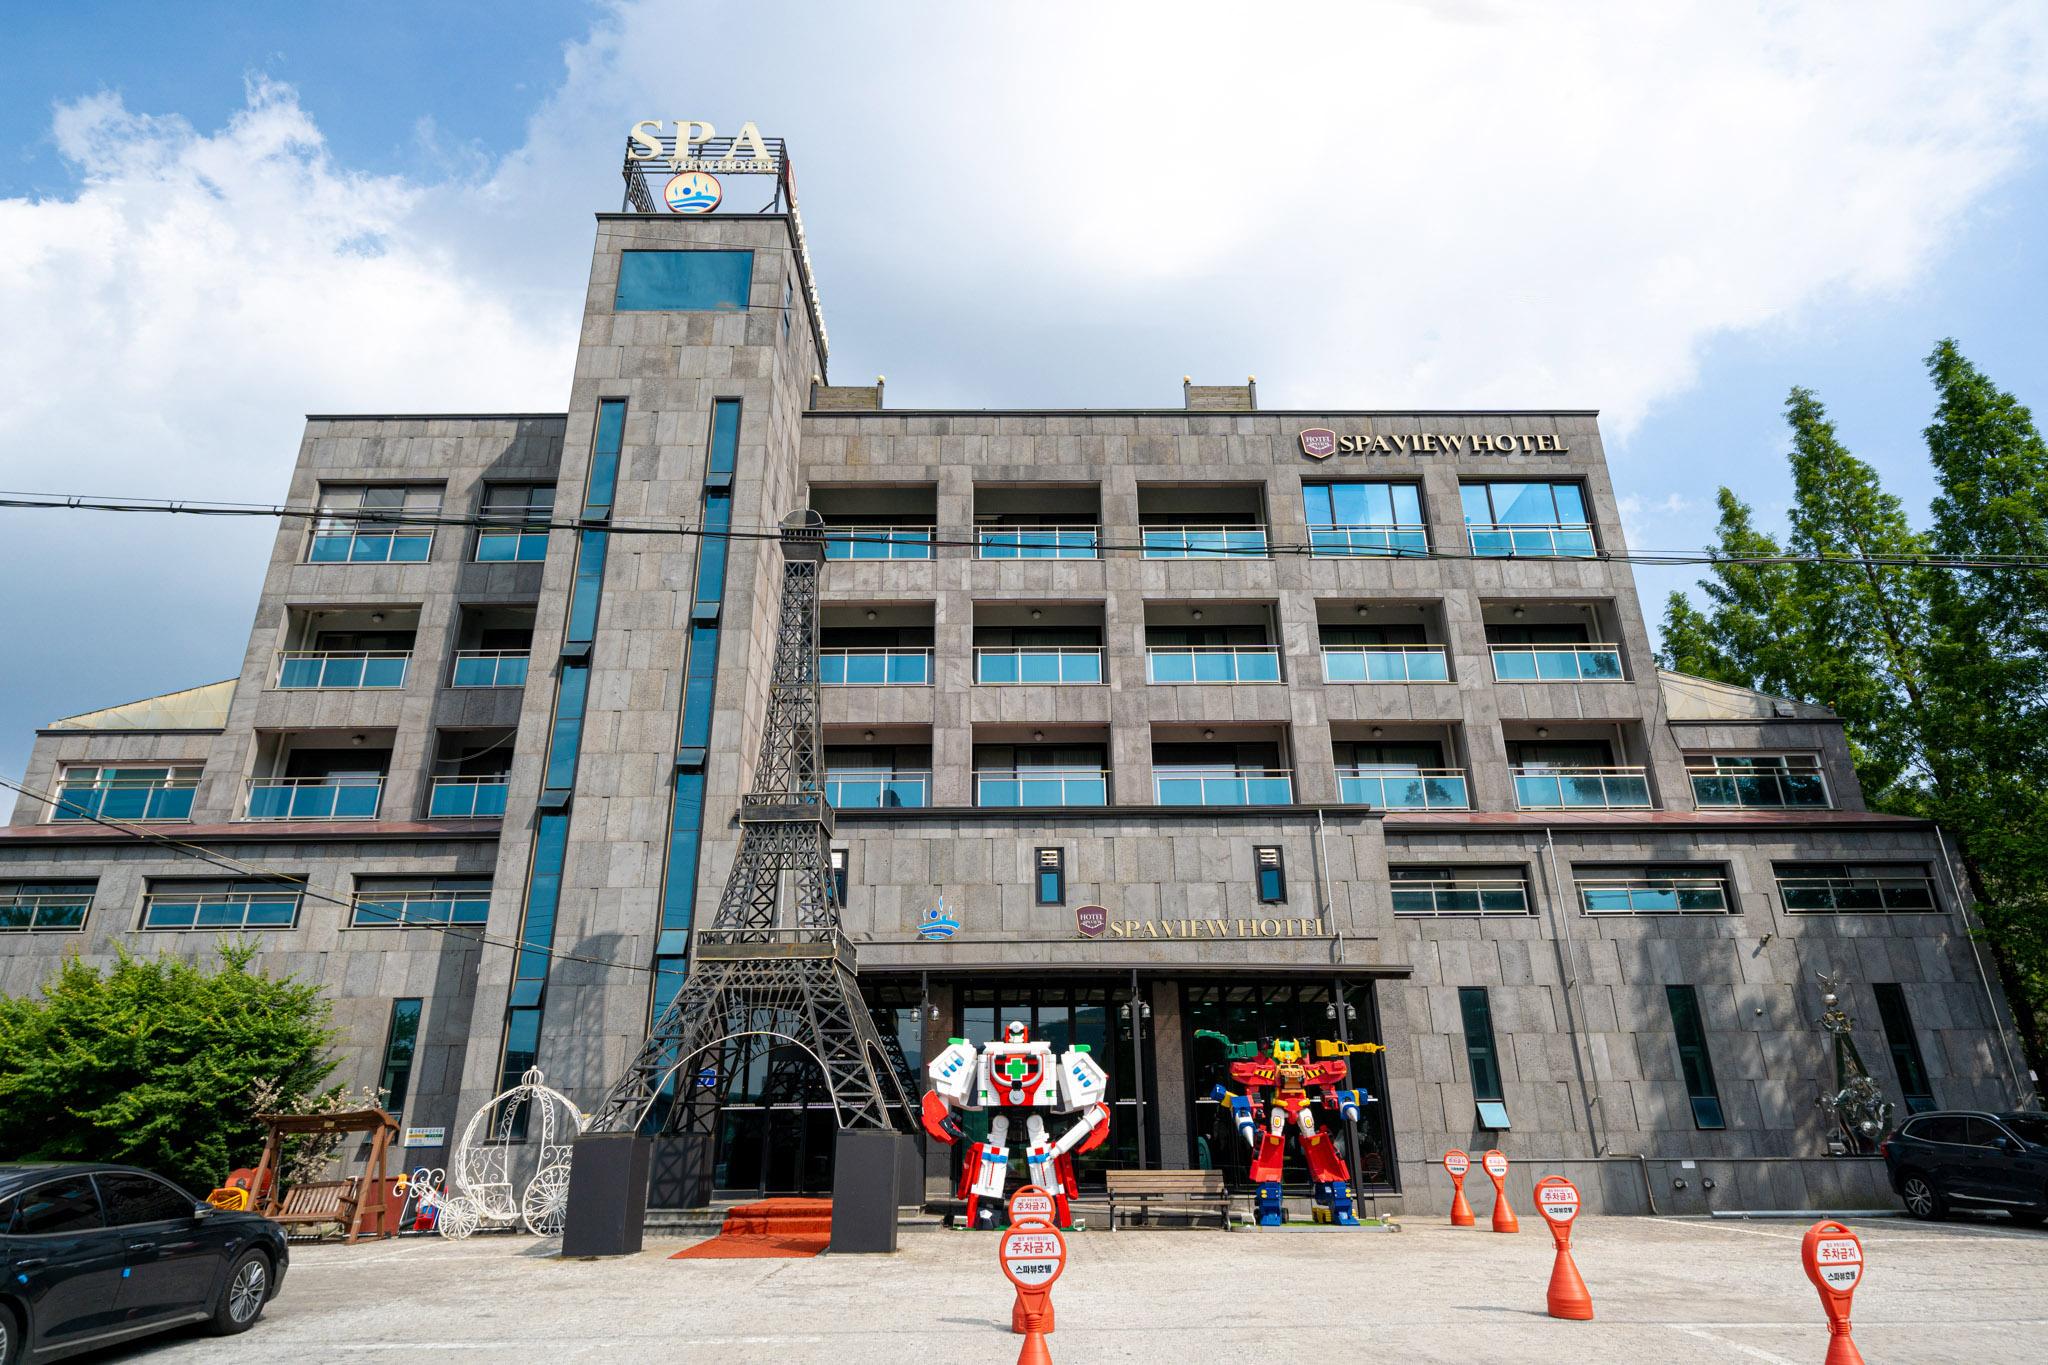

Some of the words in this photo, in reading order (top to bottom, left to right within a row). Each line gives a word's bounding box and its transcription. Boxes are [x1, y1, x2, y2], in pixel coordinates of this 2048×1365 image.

[627, 119, 776, 161] SPA
[668, 159, 715, 172] VIEW
[1340, 433, 1466, 452] SPAVIEW
[1471, 434, 1570, 452] HOTEL
[1110, 919, 1231, 938] SPAVIEW
[1236, 918, 1332, 937] HOTEL
[1545, 1192, 1574, 1201] 주차금지
[1017, 1201, 1047, 1211] 주차금지
[1011, 1241, 1055, 1254] 주차금지
[1822, 1247, 1856, 1260] 주차금지
[1016, 1264, 1052, 1274] 스파뷰호텔
